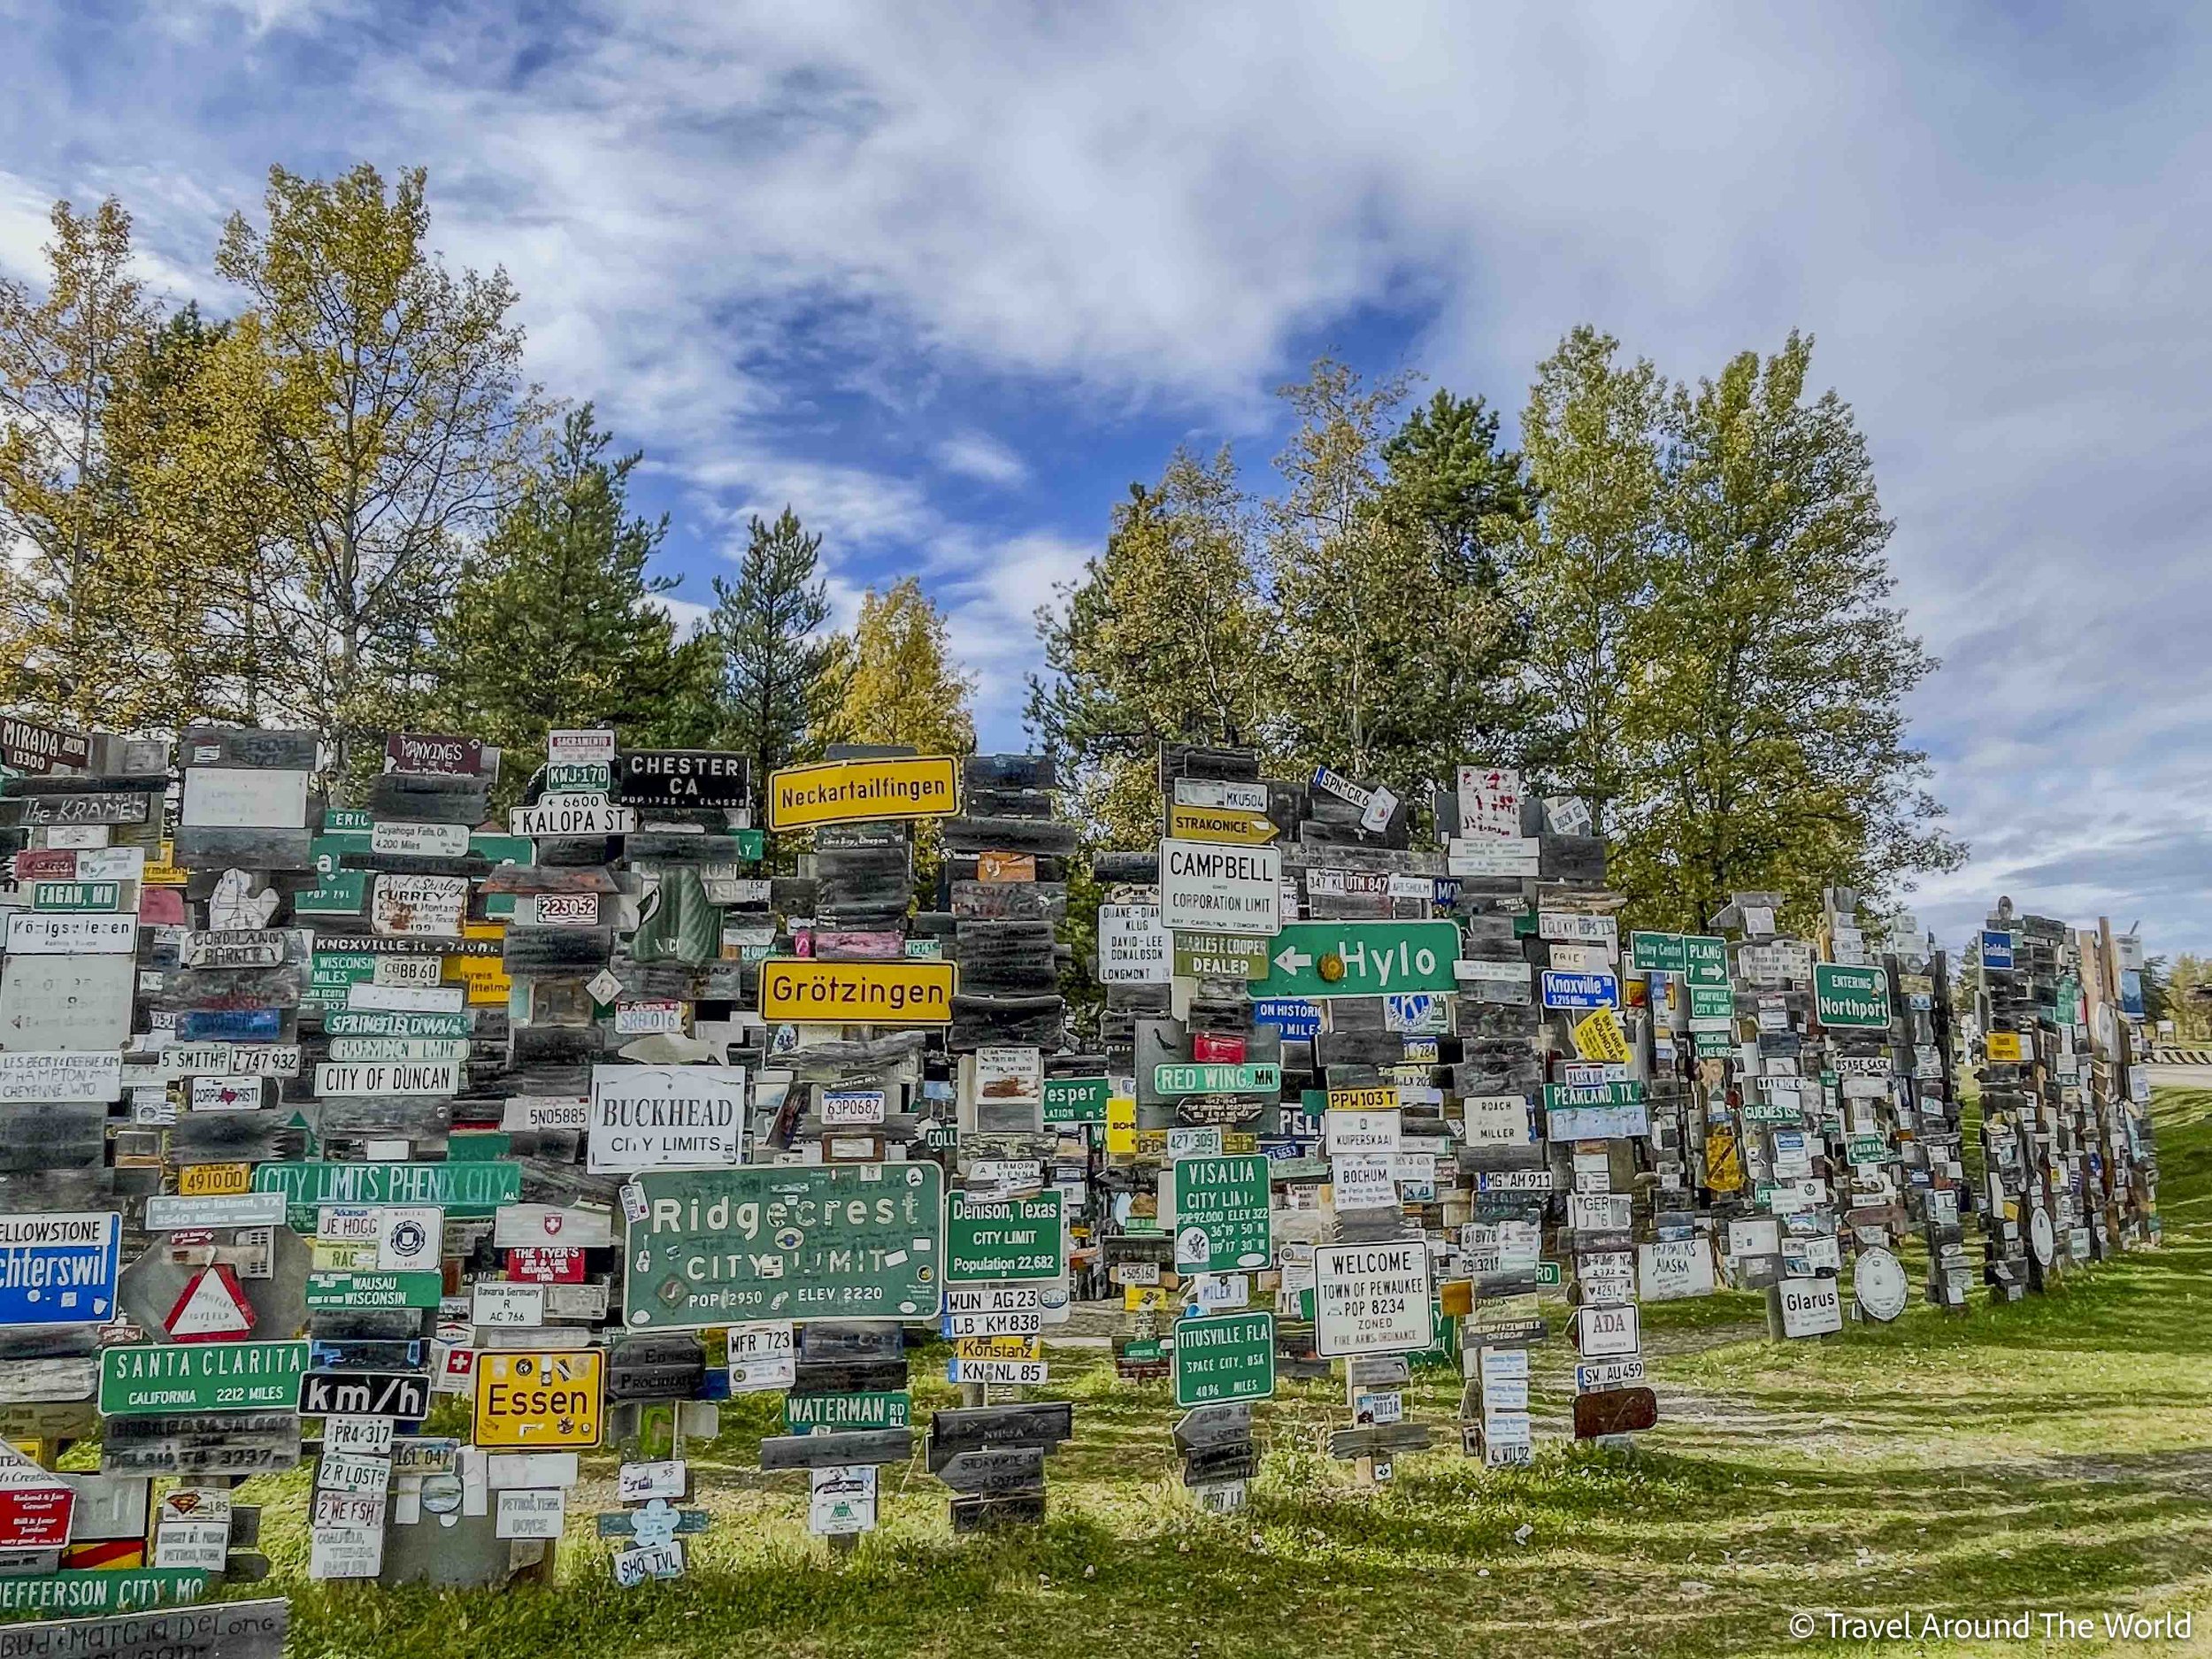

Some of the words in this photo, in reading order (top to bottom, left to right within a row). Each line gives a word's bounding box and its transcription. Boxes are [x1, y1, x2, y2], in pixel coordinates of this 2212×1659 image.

[3, 720, 59, 757] MIRADA
[12, 751, 45, 770] 13300
[631, 756, 738, 776] CHESTER
[670, 778, 698, 795] CA
[781, 780, 945, 809] Neckartailfingen
[1323, 772, 1344, 793] SPN
[1347, 786, 1363, 804] CR
[564, 796, 599, 808] 6600
[523, 810, 594, 833] KALOPA
[605, 810, 626, 830] ST
[1176, 818, 1248, 834] STRAKONICE
[377, 826, 415, 838] Cuyahoga
[401, 841, 421, 850] Miles
[1171, 852, 1274, 881] CAMPBELL
[39, 885, 87, 906] EAGAN,
[307, 890, 327, 900] POP
[378, 889, 447, 902] CURREY
[1172, 893, 1241, 912] CORPORATION
[1246, 897, 1271, 914] LIMIT
[541, 899, 596, 916] 223052
[1125, 920, 1149, 932] KLUG
[317, 938, 408, 952] KNOXVILLE
[1111, 935, 1137, 948] DAVID
[1147, 936, 1163, 948] LEE
[1226, 938, 1267, 956] COOPER
[1111, 949, 1164, 961] DONALDSON
[1689, 944, 1722, 960] PLANO
[1193, 956, 1249, 974] DEALER
[1339, 941, 1436, 987] Hylo
[313, 971, 348, 983] MILES
[1103, 968, 1150, 980] LONGMONT
[1832, 975, 1872, 990] ENTERING
[772, 974, 944, 1010] Grötzingen
[1547, 974, 1603, 995] Knoxville
[1260, 1003, 1275, 1017] ON
[1695, 1003, 1710, 1015] CITY
[1712, 1003, 1732, 1015] LIMIT
[1820, 996, 1887, 1021] Northport
[1287, 1023, 1323, 1036] MILES
[177, 1052, 219, 1068] SMITH
[244, 1053, 268, 1071] 747
[273, 1054, 296, 1071] 932
[326, 1067, 359, 1090] CITY
[367, 1067, 384, 1089] OF
[394, 1067, 450, 1089] DUNCAN
[1162, 1068, 1195, 1089] RED
[1254, 1070, 1274, 1087] MN
[602, 1098, 734, 1127] BUCKHEAD
[1481, 1101, 1511, 1111] ROACH
[1171, 1132, 1189, 1148] 427
[1195, 1131, 1219, 1148] 3097
[1337, 1133, 1392, 1147] KUIPERSKAAI
[1480, 1128, 1515, 1139] MILLER
[663, 1136, 721, 1152] LIMITS
[1188, 1163, 1255, 1185] VISALIA
[1344, 1170, 1387, 1184] BOCHUM
[266, 1165, 311, 1202] CITY
[317, 1165, 380, 1202] LIMITS
[388, 1165, 458, 1201] PHENIX
[465, 1165, 512, 1201] CITY
[171, 1199, 209, 1211] Padre
[264, 1197, 282, 1208] TX
[504, 1191, 517, 1202] AL
[1187, 1192, 1217, 1209] CITY
[1584, 1197, 1609, 1212] GER
[194, 1212, 228, 1224] Miles
[653, 1191, 918, 1241] Ridgecrest
[953, 1201, 1014, 1224] Denison,
[1018, 1200, 1057, 1219] Texas
[1252, 1209, 1269, 1220] 322
[973, 1231, 999, 1246] CITY
[1002, 1230, 1037, 1246] LIMIT
[515, 1247, 534, 1260] THE
[687, 1253, 762, 1280] CITY
[953, 1256, 1015, 1277] Population
[1018, 1255, 1055, 1272] 22,682
[1333, 1250, 1413, 1275] WELCOME
[352, 1277, 397, 1290] WAUSAU
[1323, 1284, 1351, 1301] TOWN
[1354, 1283, 1366, 1298] OF
[1370, 1279, 1423, 1296] PEWAUKEE
[345, 1291, 406, 1305] WISCONSIN
[506, 1286, 541, 1299] Germany
[689, 1293, 718, 1309] POP
[797, 1287, 836, 1302] ELEV
[843, 1286, 883, 1302] 2220
[503, 1298, 511, 1310] R
[1345, 1302, 1365, 1317] POP
[1372, 1299, 1405, 1316] 8234
[1787, 1291, 1835, 1312] Glarus
[490, 1311, 503, 1322] AC
[506, 1311, 525, 1322] 766
[1357, 1317, 1394, 1331] ZONED
[1594, 1313, 1625, 1333] ADA
[765, 1331, 790, 1351] 723
[1334, 1334, 1354, 1347] FIRE
[963, 1339, 1033, 1360] Konstanz
[116, 1353, 190, 1379] SANTA
[203, 1348, 301, 1375] CLARITA
[1187, 1360, 1214, 1374] SPACE
[128, 1390, 196, 1406] CALIFORNIA
[216, 1387, 244, 1402] 2212
[249, 1386, 284, 1401] MILES
[308, 1378, 420, 1413] km/h
[1195, 1384, 1219, 1398] 4096
[1233, 1379, 1257, 1394] MILES
[488, 1384, 588, 1416] Essen
[787, 1396, 885, 1423] WATERMAN
[889, 1402, 905, 1417] RD
[322, 1463, 330, 1480] 2
[334, 1464, 344, 1482] R
[346, 1466, 375, 1486] LOST
[319, 1501, 327, 1519] 2
[351, 1502, 375, 1521] FSH
[117, 1578, 165, 1609] CITY
